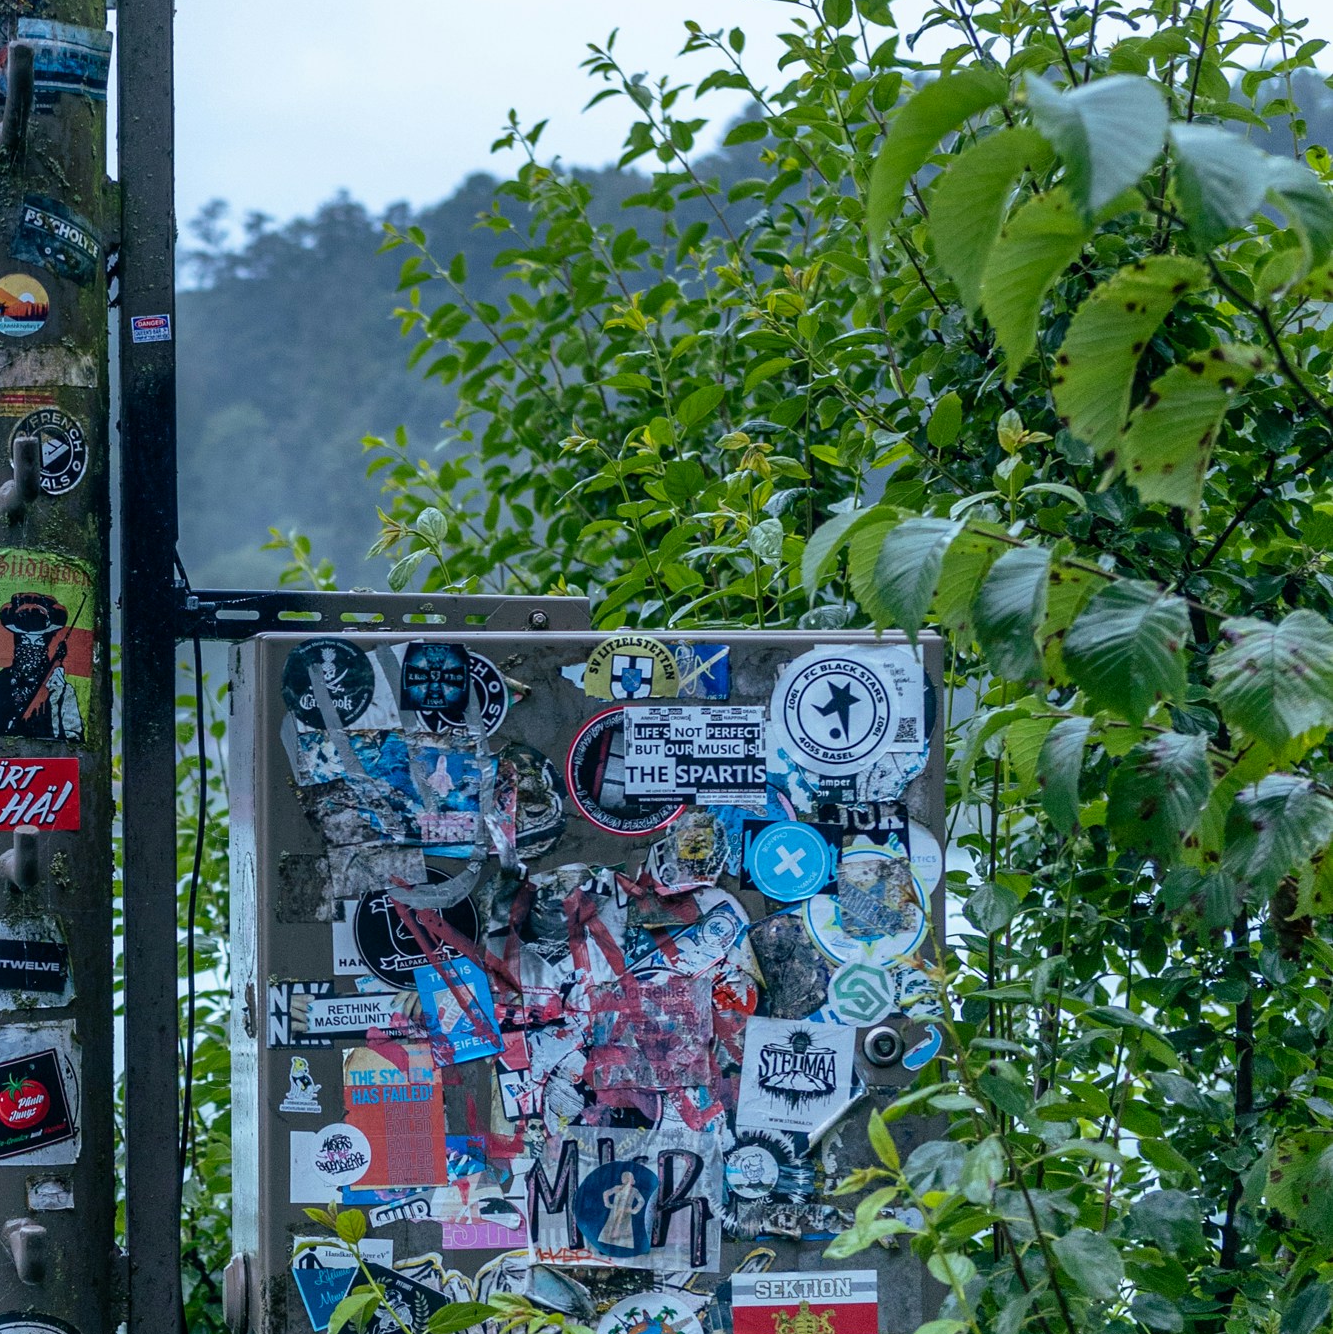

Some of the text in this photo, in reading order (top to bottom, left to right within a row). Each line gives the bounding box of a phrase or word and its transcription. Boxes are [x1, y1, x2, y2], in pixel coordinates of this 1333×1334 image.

[29, 412, 83, 452] FRENCH
[588, 636, 676, 681] SV LITZELSTETTEN
[803, 663, 885, 705] FC BLACK STARS
[787, 688, 801, 711] 1907
[634, 727, 760, 738] LIFE'S NOT PERFECT
[872, 715, 886, 738] 1907
[635, 744, 760, 755] BUT OUR MUSIC IS!
[798, 736, 856, 761] 4055 BASEL
[625, 765, 766, 784] THE SPARTIS
[460, 965, 472, 975] IS
[327, 1002, 381, 1015] RETHINK
[315, 1013, 393, 1027] MASCULINITY
[350, 1070, 377, 1086] THE
[351, 1085, 434, 1105] HAS FAILED!
[384, 1102, 431, 1119] FAILED
[386, 1119, 432, 1136] FAILED
[387, 1135, 433, 1153] FAILED
[388, 1152, 433, 1170] FAILED
[754, 1278, 852, 1300] SEKTION
